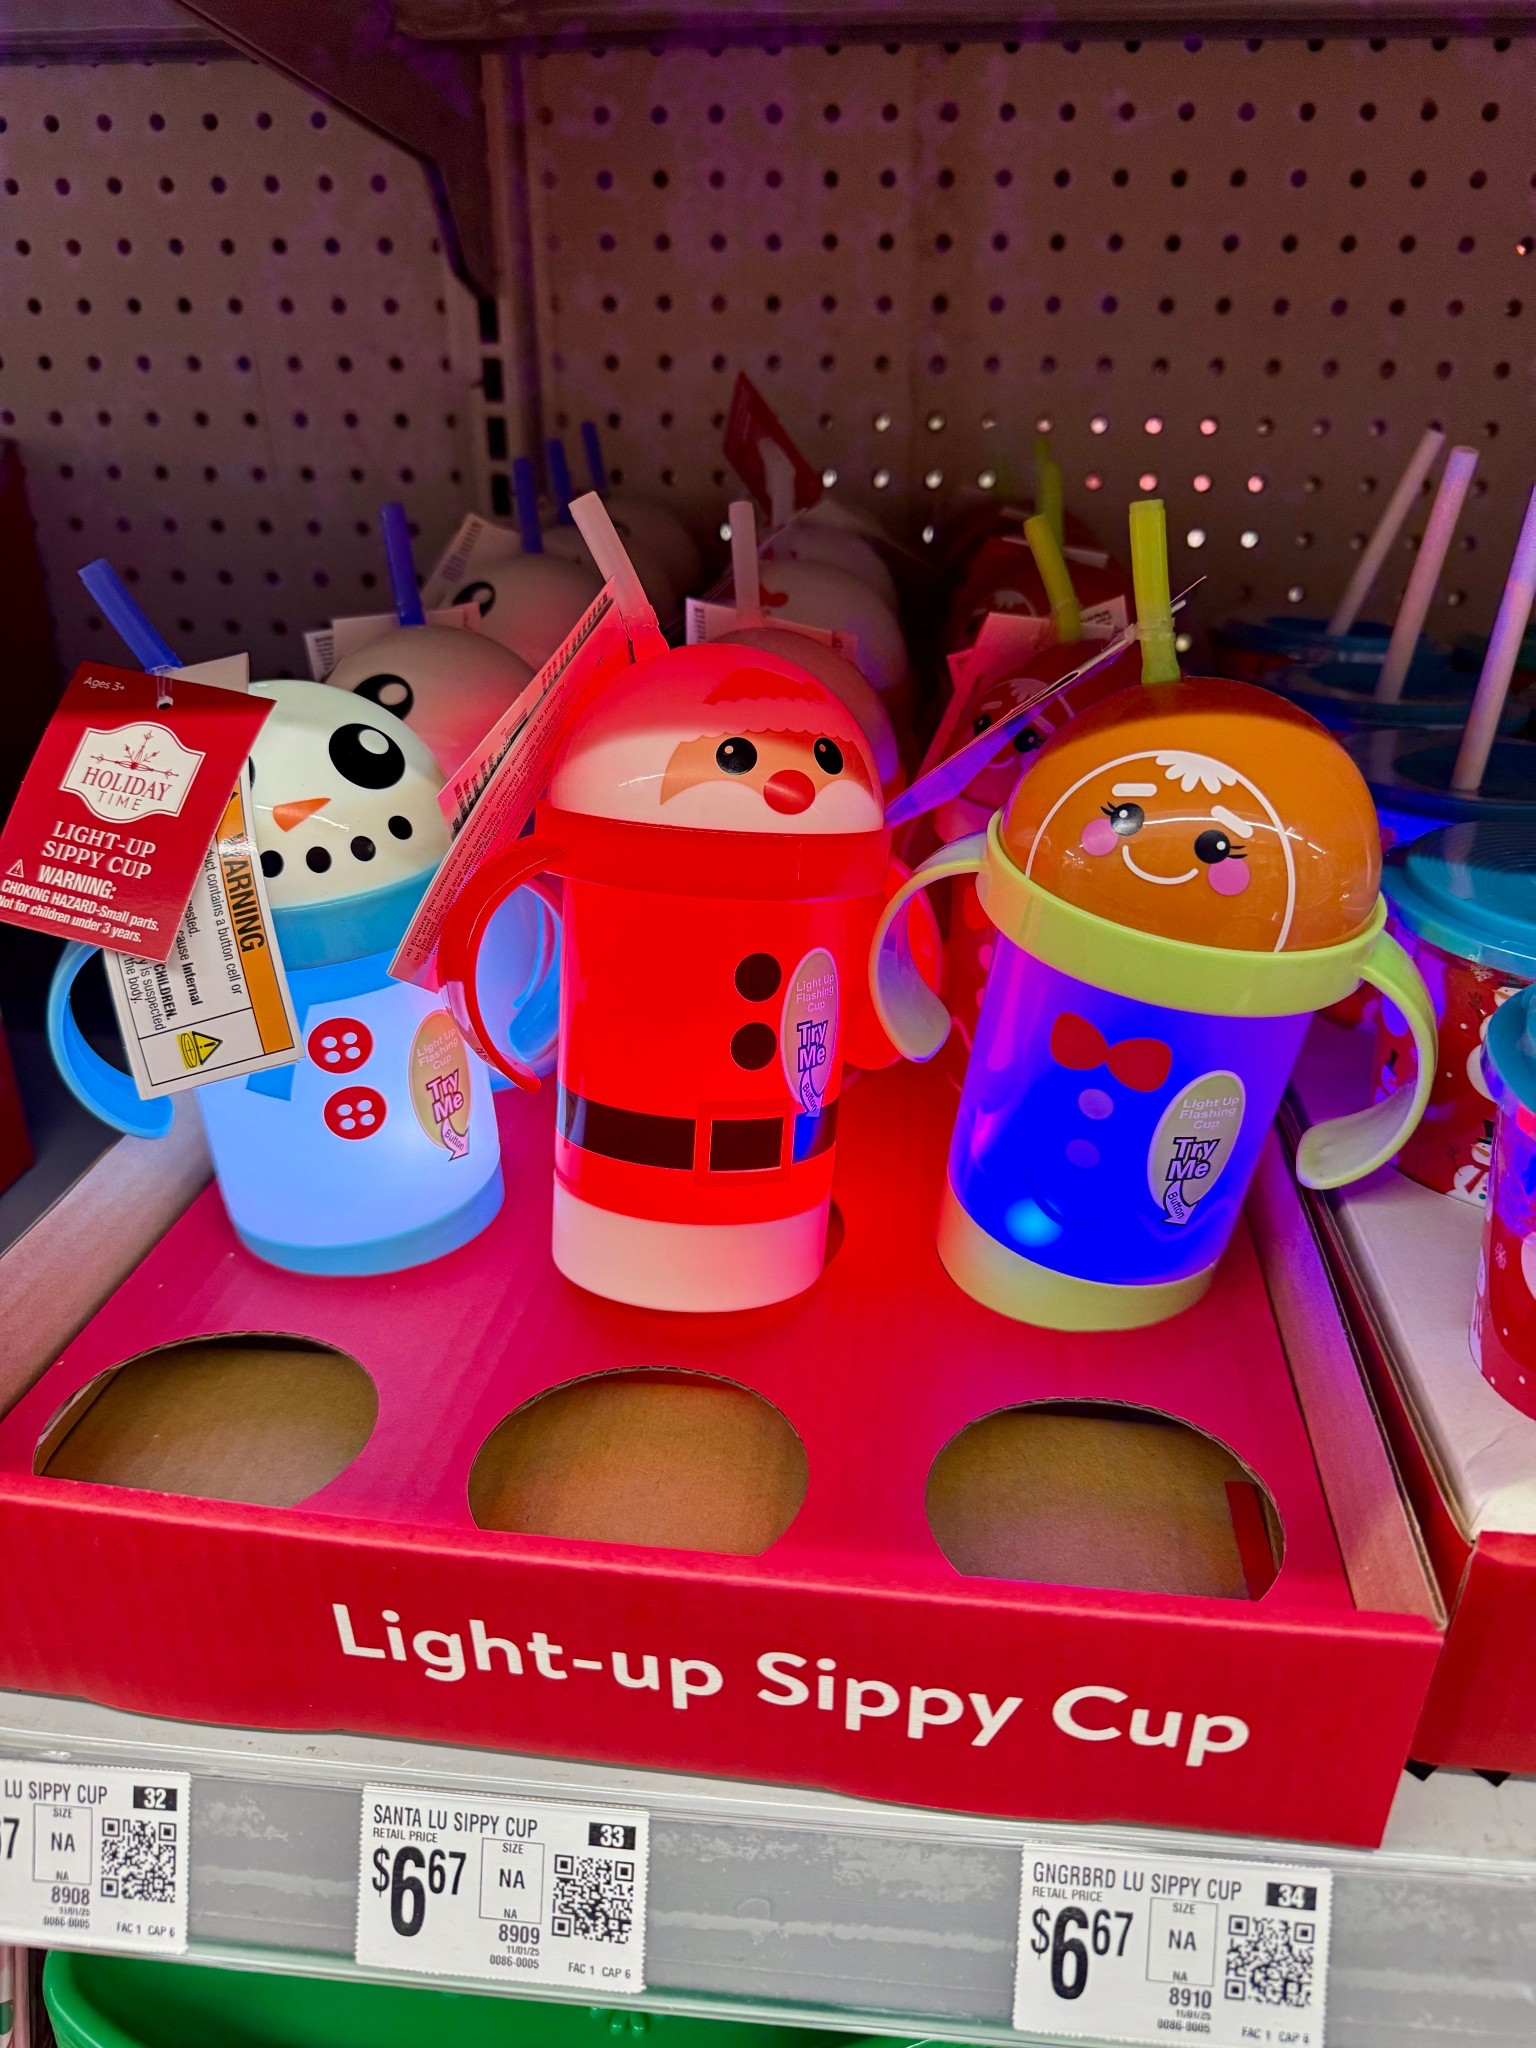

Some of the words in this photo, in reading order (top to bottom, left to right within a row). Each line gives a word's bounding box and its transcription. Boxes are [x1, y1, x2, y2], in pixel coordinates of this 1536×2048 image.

[83, 676, 111, 690] Ages
[112, 682, 125, 692] 3+
[81, 766, 173, 801] HOLIDAY
[98, 790, 143, 812] TIME
[51, 820, 156, 858] LIGHT-UP
[41, 840, 105, 868] SIPPY
[107, 856, 152, 879] CUP
[36, 864, 117, 900] WARNING:
[426, 898, 436, 913] the
[434, 858, 457, 897] batteries
[456, 842, 467, 858] are
[1, 879, 50, 903] CHOKING
[50, 892, 130, 923] HAZARD-Small
[130, 913, 160, 931] parts.
[206, 873, 225, 917] contains
[14, 898, 30, 913] for
[30, 905, 71, 924] children
[72, 916, 102, 932] under
[102, 922, 110, 934] 3
[110, 926, 142, 943] years.
[215, 918, 225, 926] a
[177, 930, 190, 960] cause
[216, 926, 236, 961] button
[123, 956, 138, 975] the
[139, 966, 153, 976] is
[226, 961, 241, 981] cell
[125, 976, 144, 1004] body.
[153, 963, 177, 1020] CHILDREN.
[181, 961, 203, 1006] Internal
[230, 983, 241, 995] or
[796, 978, 822, 992] Light
[824, 974, 834, 987] Up
[796, 985, 834, 1004] Flashing
[142, 978, 166, 1031] suspected
[807, 1000, 825, 1013] Cup
[416, 1035, 445, 1057] Light
[444, 1027, 457, 1042] Up
[797, 1020, 829, 1050] Try
[418, 1037, 459, 1068] Flashing
[433, 1054, 452, 1070] Cup
[798, 1044, 827, 1073] Me
[426, 1068, 459, 1101] Try
[432, 1091, 464, 1125] Me
[802, 1081, 818, 1112] Button
[1182, 1099, 1219, 1110] Light
[1223, 1096, 1239, 1106] Up
[1180, 1107, 1236, 1119] Flashing
[1193, 1120, 1220, 1130] Cup
[444, 1128, 465, 1151] Button
[1173, 1136, 1220, 1160] Try
[1165, 1158, 1211, 1182] Me
[1167, 1191, 1185, 1219] Button
[331, 1602, 724, 1711] Light-up
[755, 1649, 1024, 1748] Sippy
[1051, 1684, 1251, 1769] Cup
[4, 1778, 23, 1799] LU
[29, 1780, 72, 1802] SIPPY
[77, 1784, 108, 1804] CUP
[144, 1787, 167, 1809] 32
[53, 1806, 73, 1819] SIZE
[373, 1803, 422, 1828] SANTA
[429, 1810, 447, 1830] LU
[453, 1811, 500, 1836] SIPPY
[505, 1816, 538, 1839] CUP
[0, 1817, 20, 1860] 7
[51, 1831, 76, 1853] NA
[372, 1826, 406, 1841] RETAIL
[408, 1829, 438, 1843] PRICE
[599, 1825, 625, 1848] 33
[502, 1842, 524, 1855] SIZE
[56, 1870, 69, 1881] NA
[499, 1868, 526, 1889] NA
[1033, 1861, 1116, 1889] GNGRBRD
[1124, 1870, 1144, 1891] LU
[1151, 1873, 1201, 1898] SIPPY
[1207, 1879, 1242, 1901] CUP
[51, 1885, 90, 1906] 8908
[1032, 1886, 1068, 1899] RETAIL
[1071, 1889, 1103, 1902] PRICE
[1278, 1884, 1305, 1908] 34
[503, 1908, 518, 1920] NA
[1172, 1902, 1196, 1914] SIZE
[116, 1921, 134, 1934] FAC
[136, 1924, 142, 1934] 1
[148, 1925, 167, 1936] CAP
[169, 1927, 176, 1938] 6
[499, 1923, 541, 1945] 8909
[1168, 1928, 1197, 1951] NA
[489, 1954, 540, 1969] 0086-0005
[506, 1945, 540, 1956] 11/01/25
[568, 1961, 586, 1974] FAC
[589, 1964, 595, 1975] 1
[602, 1966, 622, 1978] CAP
[625, 1967, 631, 1979] 6
[1172, 1970, 1188, 1982] NA
[1168, 1986, 1212, 2009] 8910
[1241, 2026, 1261, 2039] FAC
[1279, 2031, 1300, 2043] CAP
